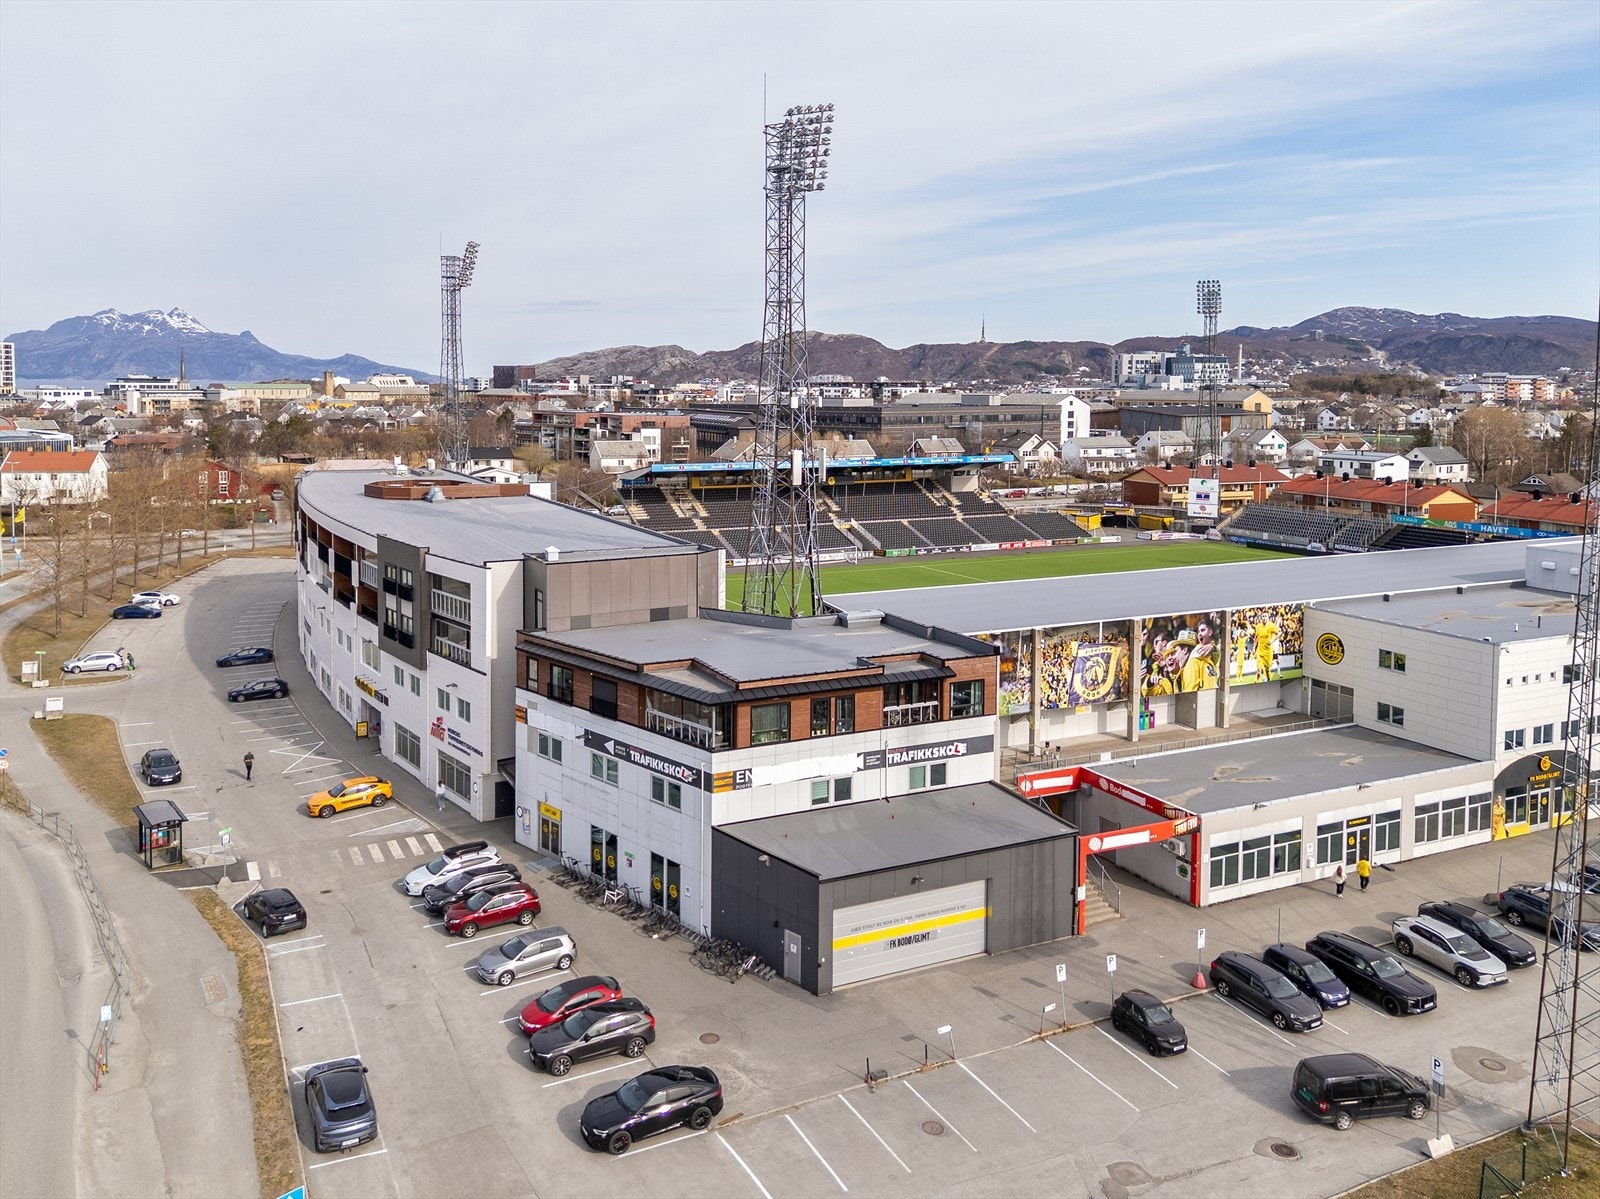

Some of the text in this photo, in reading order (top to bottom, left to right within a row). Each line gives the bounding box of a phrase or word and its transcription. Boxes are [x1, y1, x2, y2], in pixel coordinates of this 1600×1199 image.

[1480, 524, 1509, 534] HAVET
[887, 742, 967, 764] TRAFIKKSKOLE
[889, 932, 931, 949] FK BODØ/GLIMT
[1109, 957, 1114, 965] P
[1059, 966, 1063, 974] P
[1433, 1058, 1441, 1070] P
